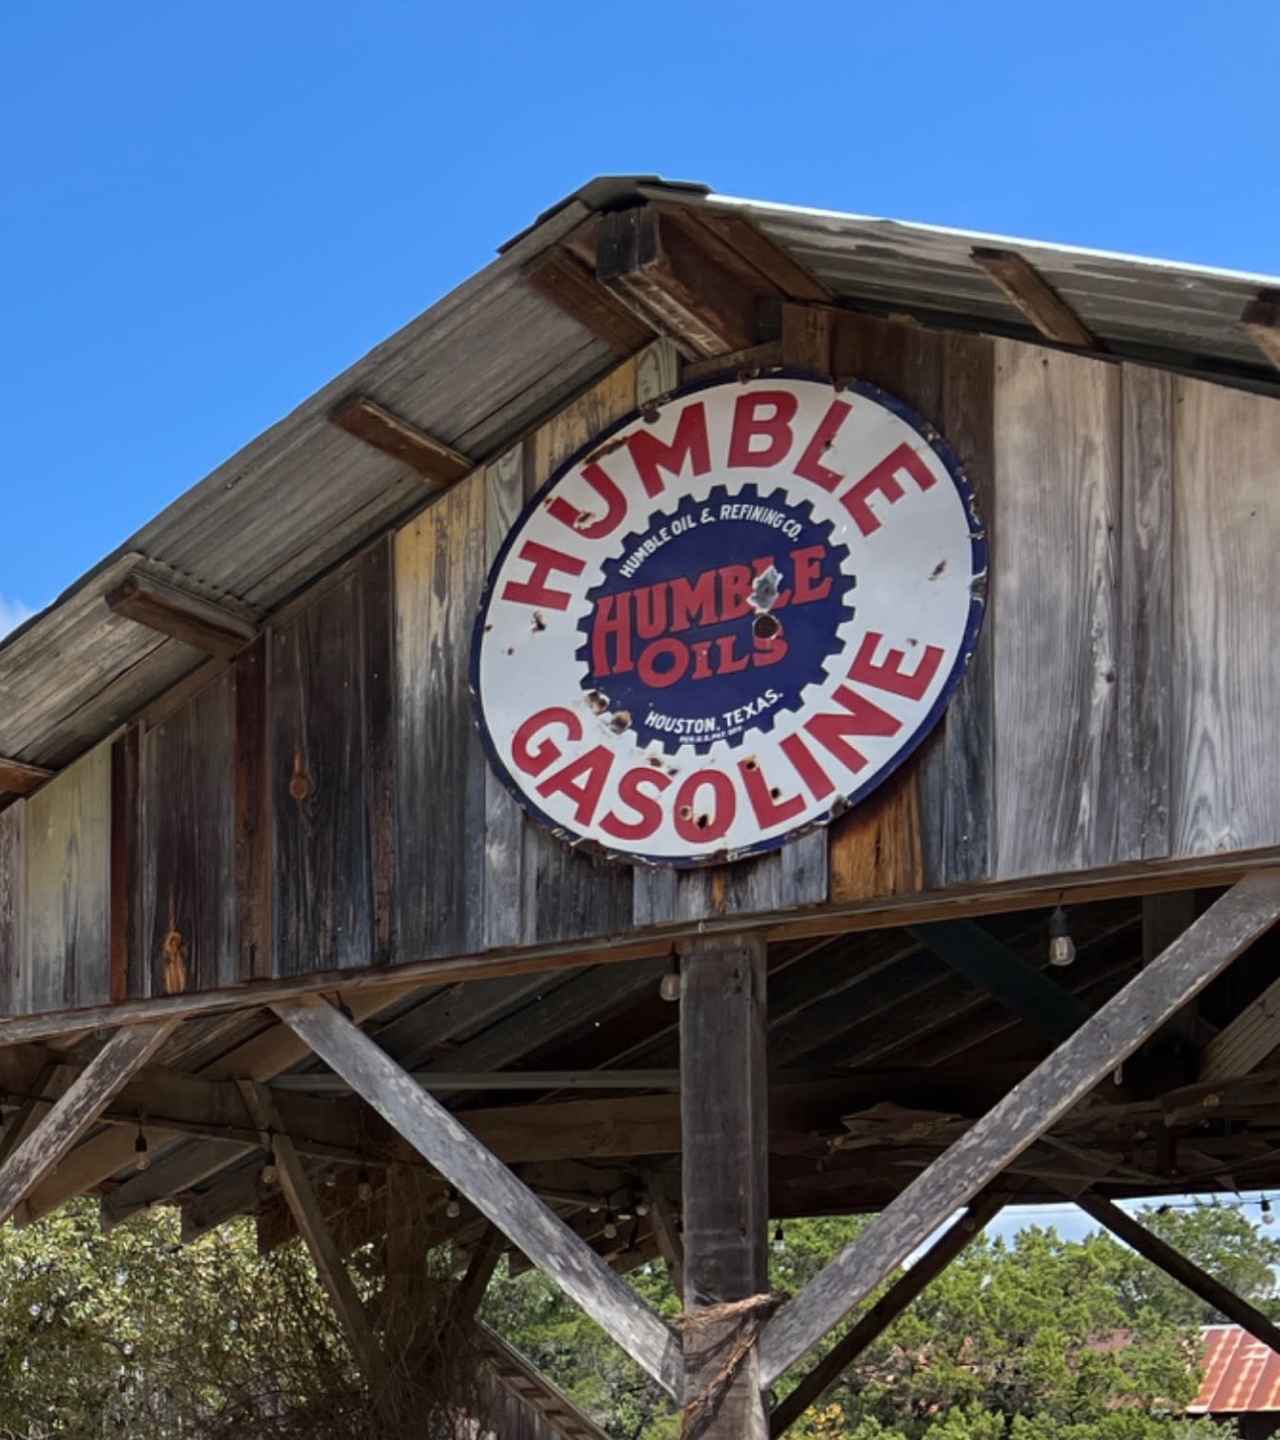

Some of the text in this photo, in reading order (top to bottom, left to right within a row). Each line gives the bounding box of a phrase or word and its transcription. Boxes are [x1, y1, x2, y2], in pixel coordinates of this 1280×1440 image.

[502, 391, 936, 610] HUMBLE
[620, 528, 671, 577] HUMBLE
[672, 515, 696, 536] OIL
[700, 508, 715, 523] &
[720, 504, 786, 528] REFINING
[638, 617, 788, 688] OILS
[511, 632, 945, 843] GASOLINE
[723, 689, 784, 727] TEXAS.
